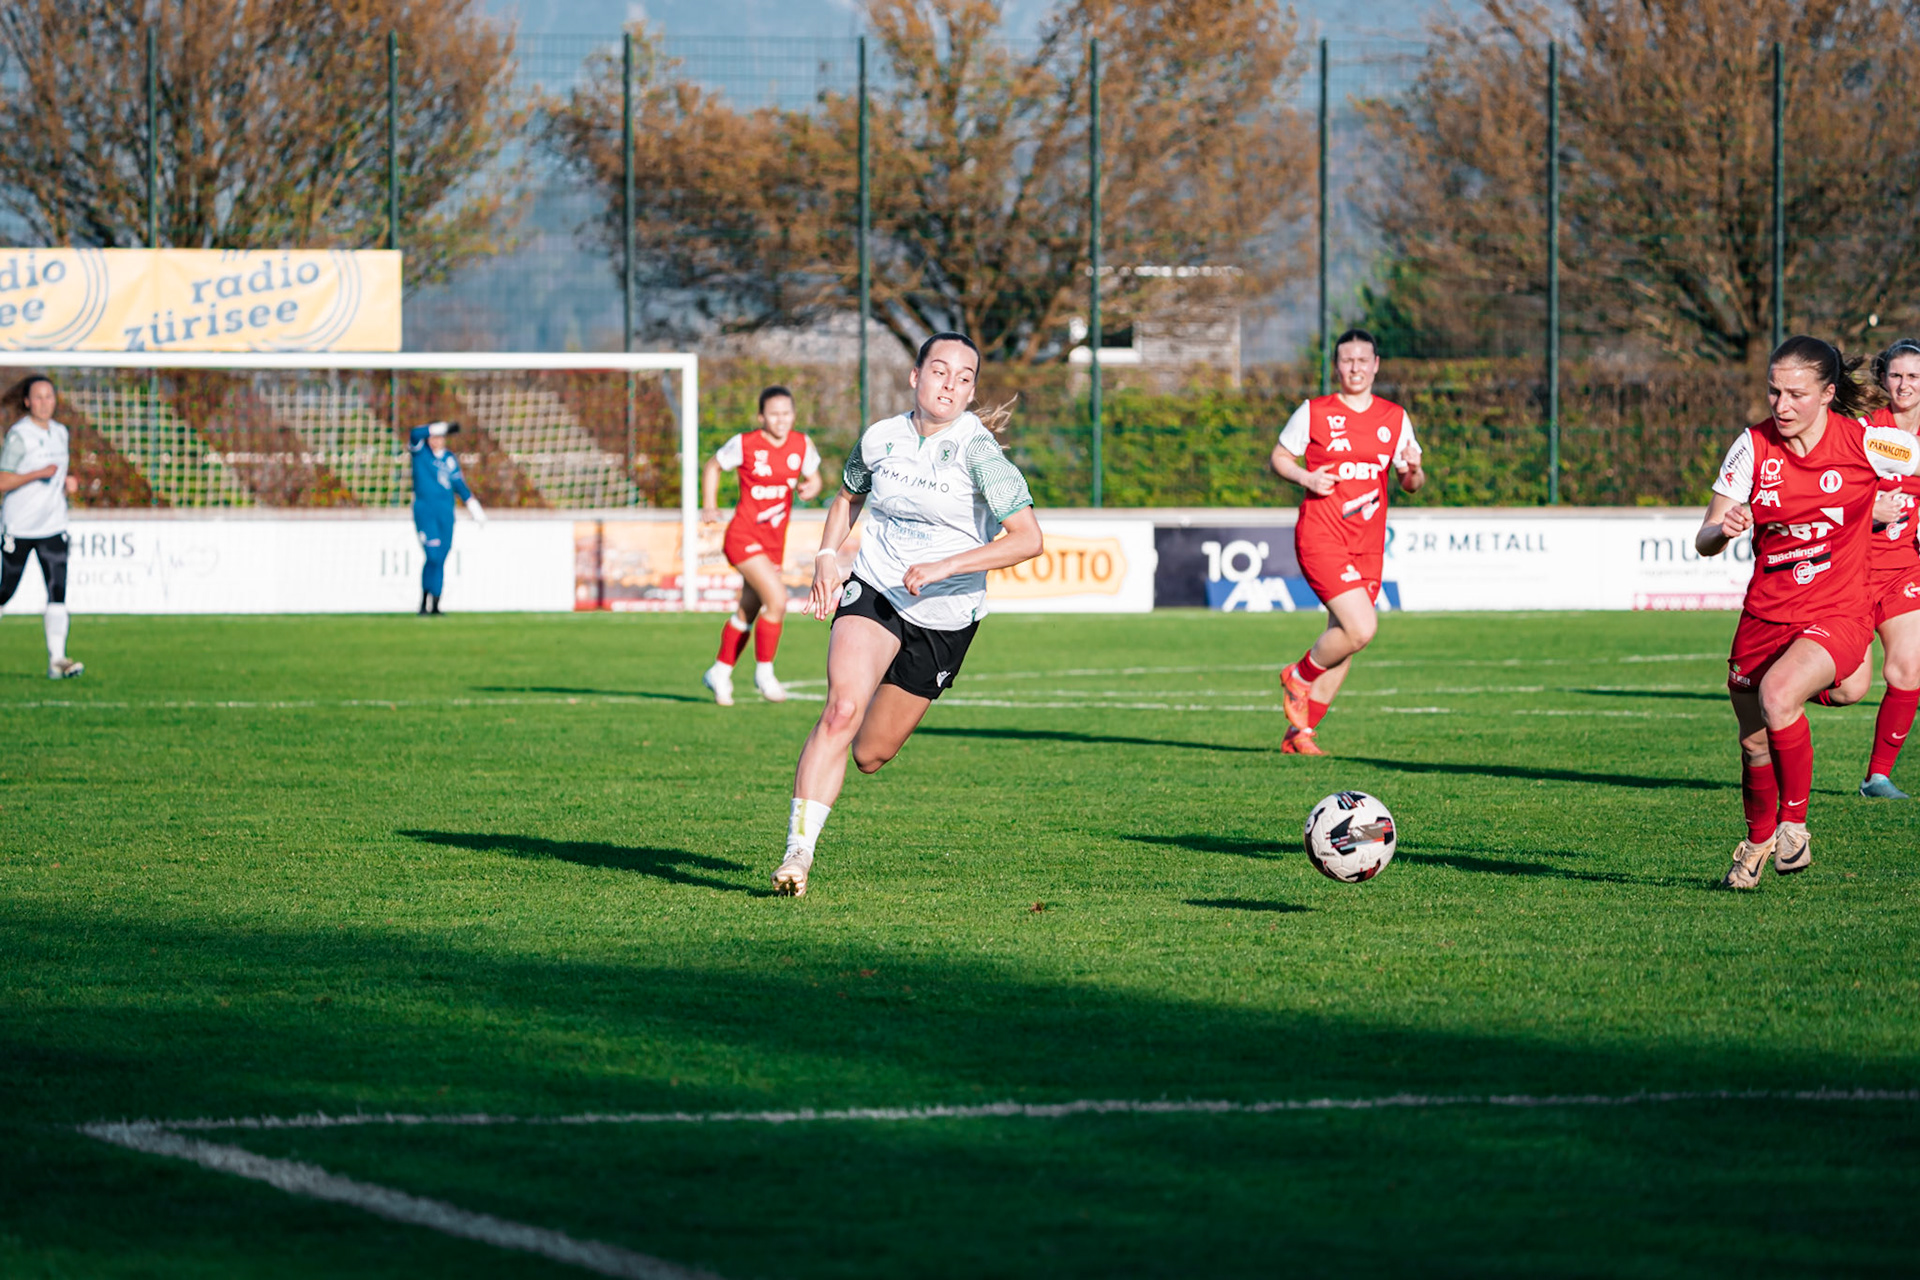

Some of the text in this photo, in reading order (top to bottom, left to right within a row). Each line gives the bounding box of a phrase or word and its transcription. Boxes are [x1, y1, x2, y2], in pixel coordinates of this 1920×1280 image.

[191, 255, 320, 304] radio
[124, 298, 298, 351] zürisee
[1869, 441, 1910, 459] PARMACOTTO
[1752, 489, 1781, 507] AXA
[1405, 532, 1548, 552] 2R METALL
